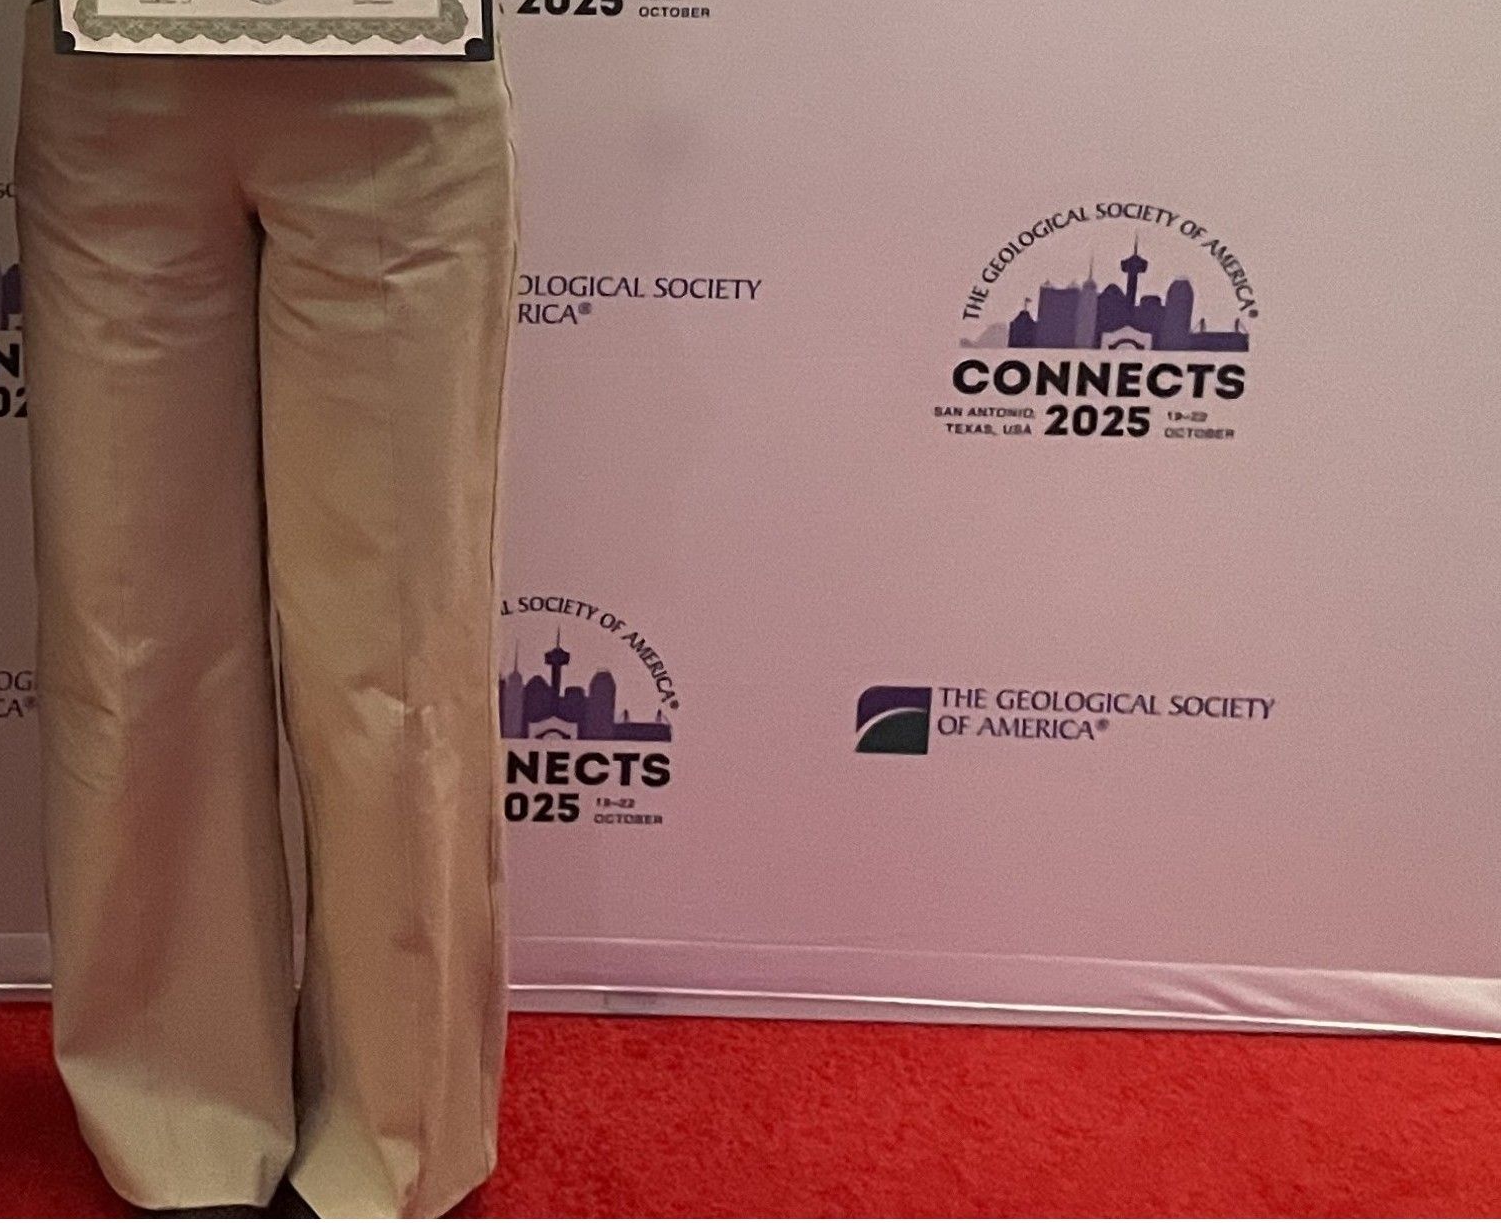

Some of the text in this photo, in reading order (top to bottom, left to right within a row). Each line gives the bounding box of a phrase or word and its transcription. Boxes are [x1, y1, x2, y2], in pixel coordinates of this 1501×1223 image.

[952, 360, 1247, 400] CONNECTS
[1045, 405, 1152, 439] 2025
[939, 687, 1275, 721] THE GEOLOGICAL SOCIETY
[939, 714, 973, 738] OF
